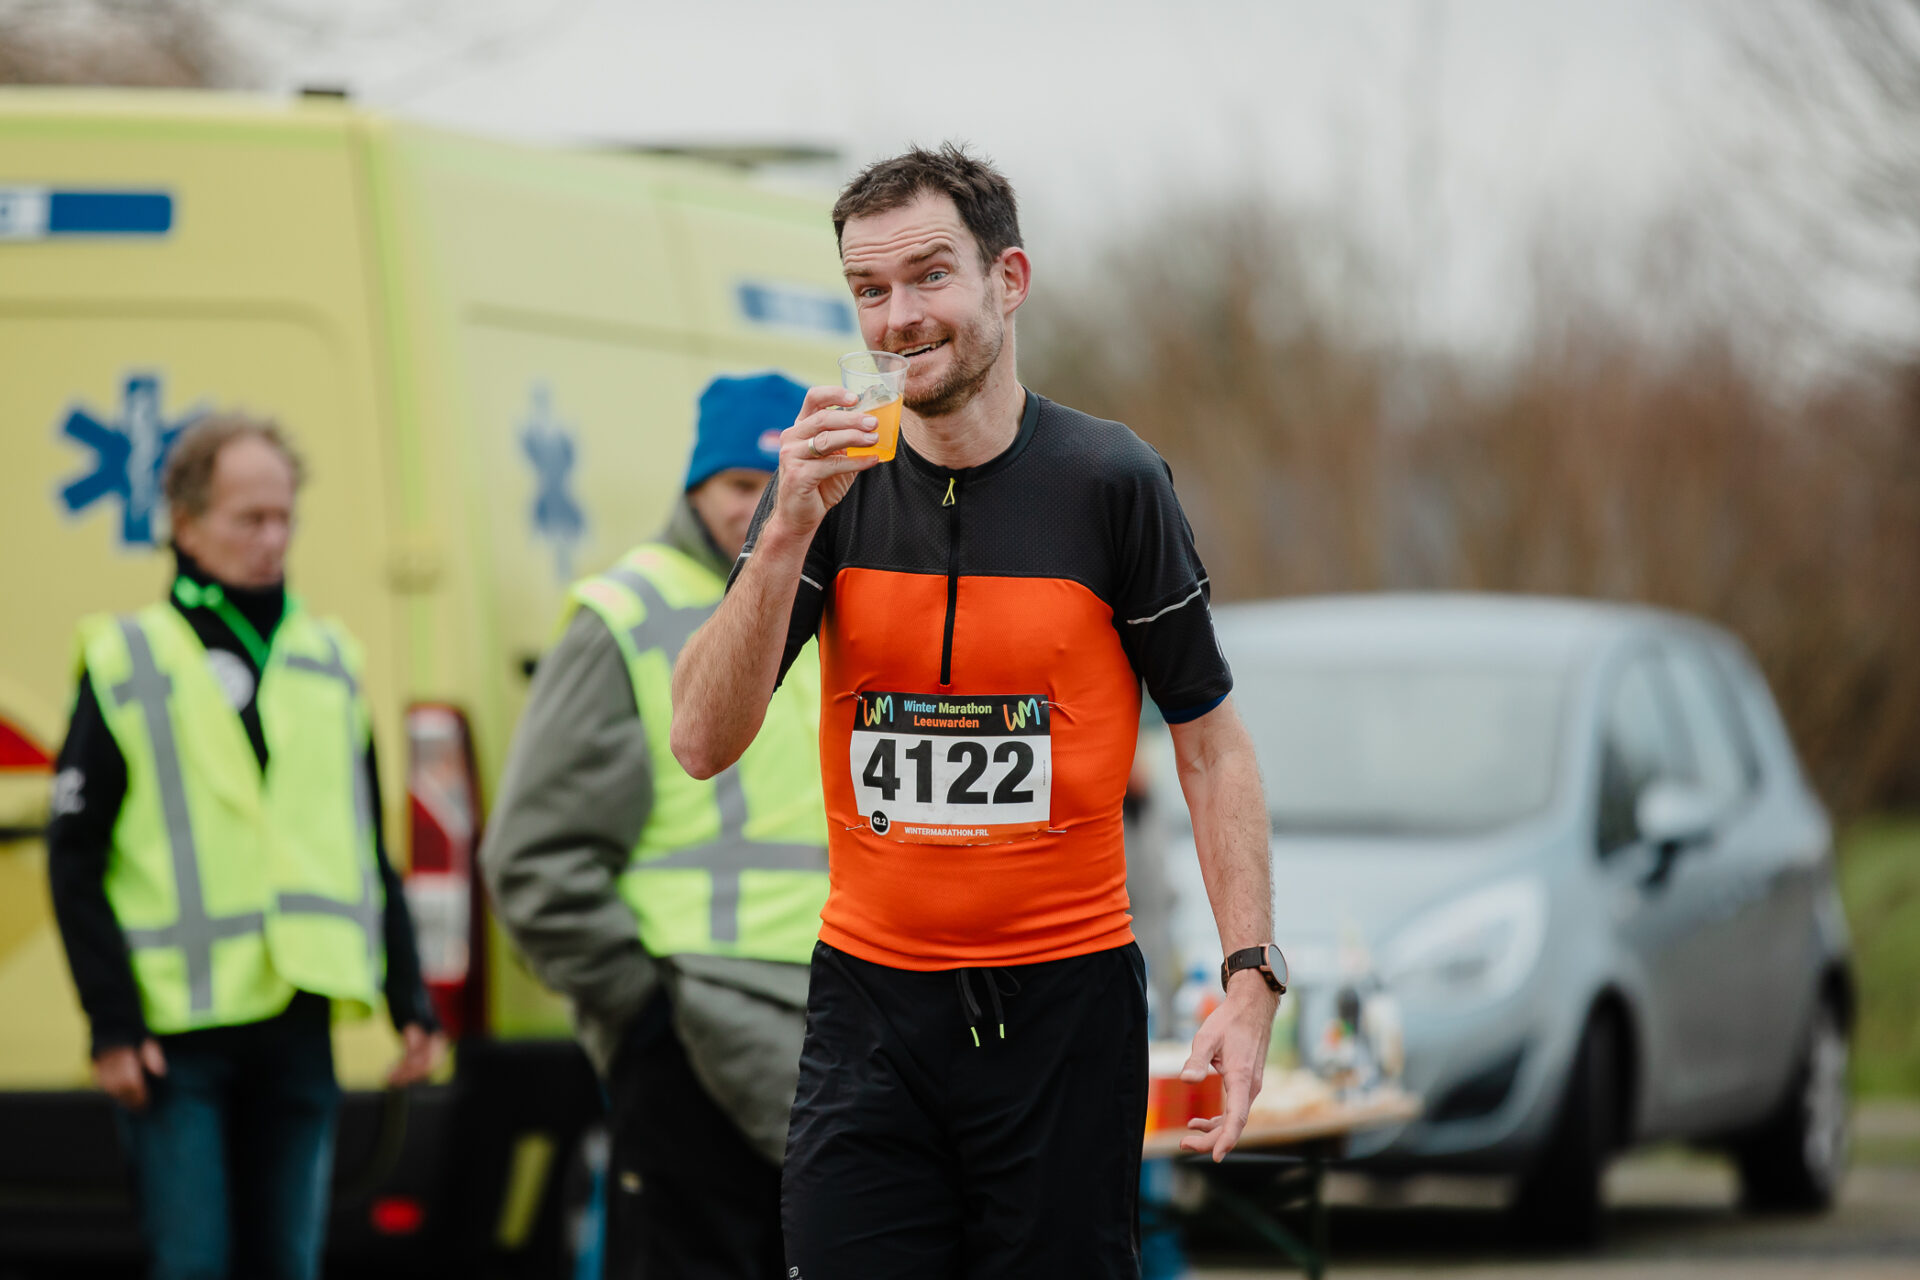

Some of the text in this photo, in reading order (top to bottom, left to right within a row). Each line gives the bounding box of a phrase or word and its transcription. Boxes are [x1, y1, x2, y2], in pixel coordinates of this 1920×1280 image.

[904, 700, 992, 714] Winter Marathon
[914, 715, 980, 728] Leeuwarden
[862, 738, 1034, 804] 4122
[873, 816, 887, 826] 42.2
[904, 826, 989, 837] WINTERMARATHON.FRL
